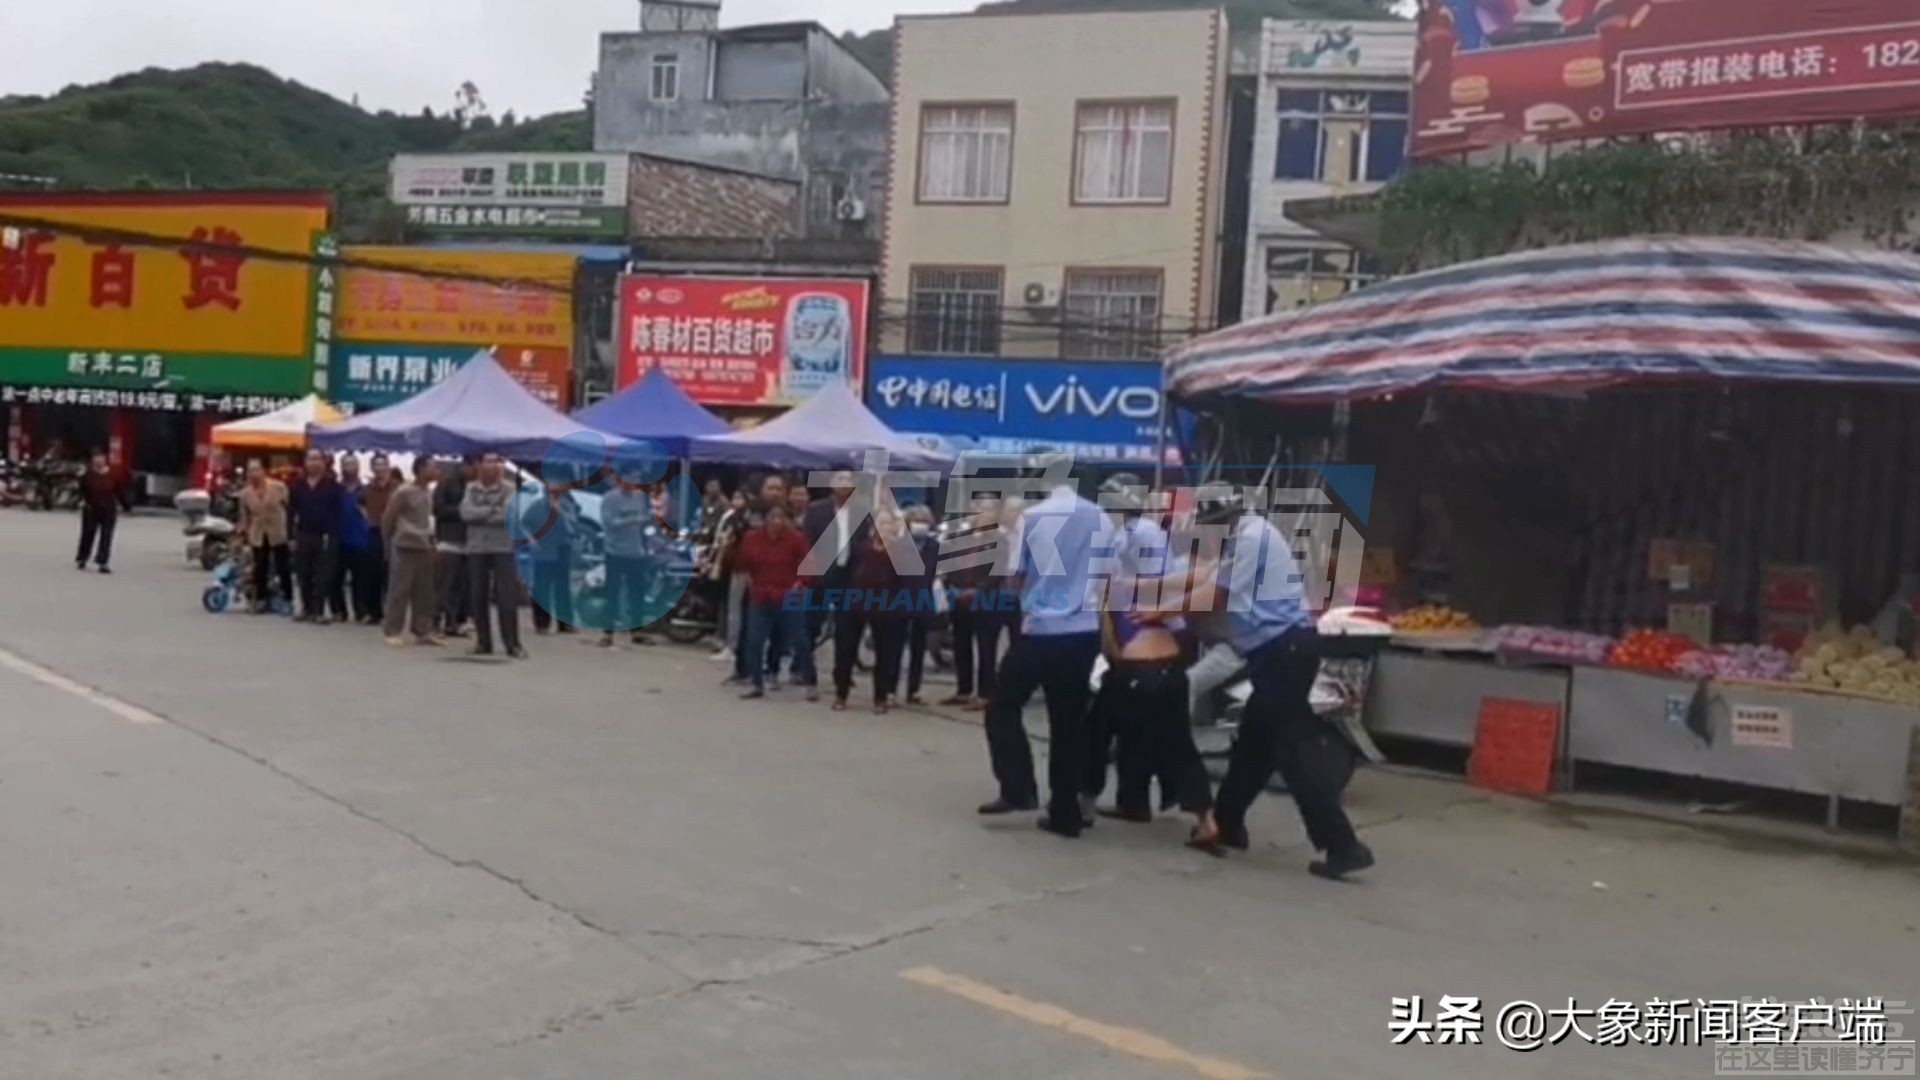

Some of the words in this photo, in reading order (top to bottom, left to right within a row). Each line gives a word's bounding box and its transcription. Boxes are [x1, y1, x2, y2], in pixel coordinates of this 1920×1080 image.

[1625, 45, 1838, 94] 宽带报装电话：
[1861, 39, 1920, 69] 182
[906, 376, 996, 410] 中国电信
[1024, 374, 1160, 417] vivo
